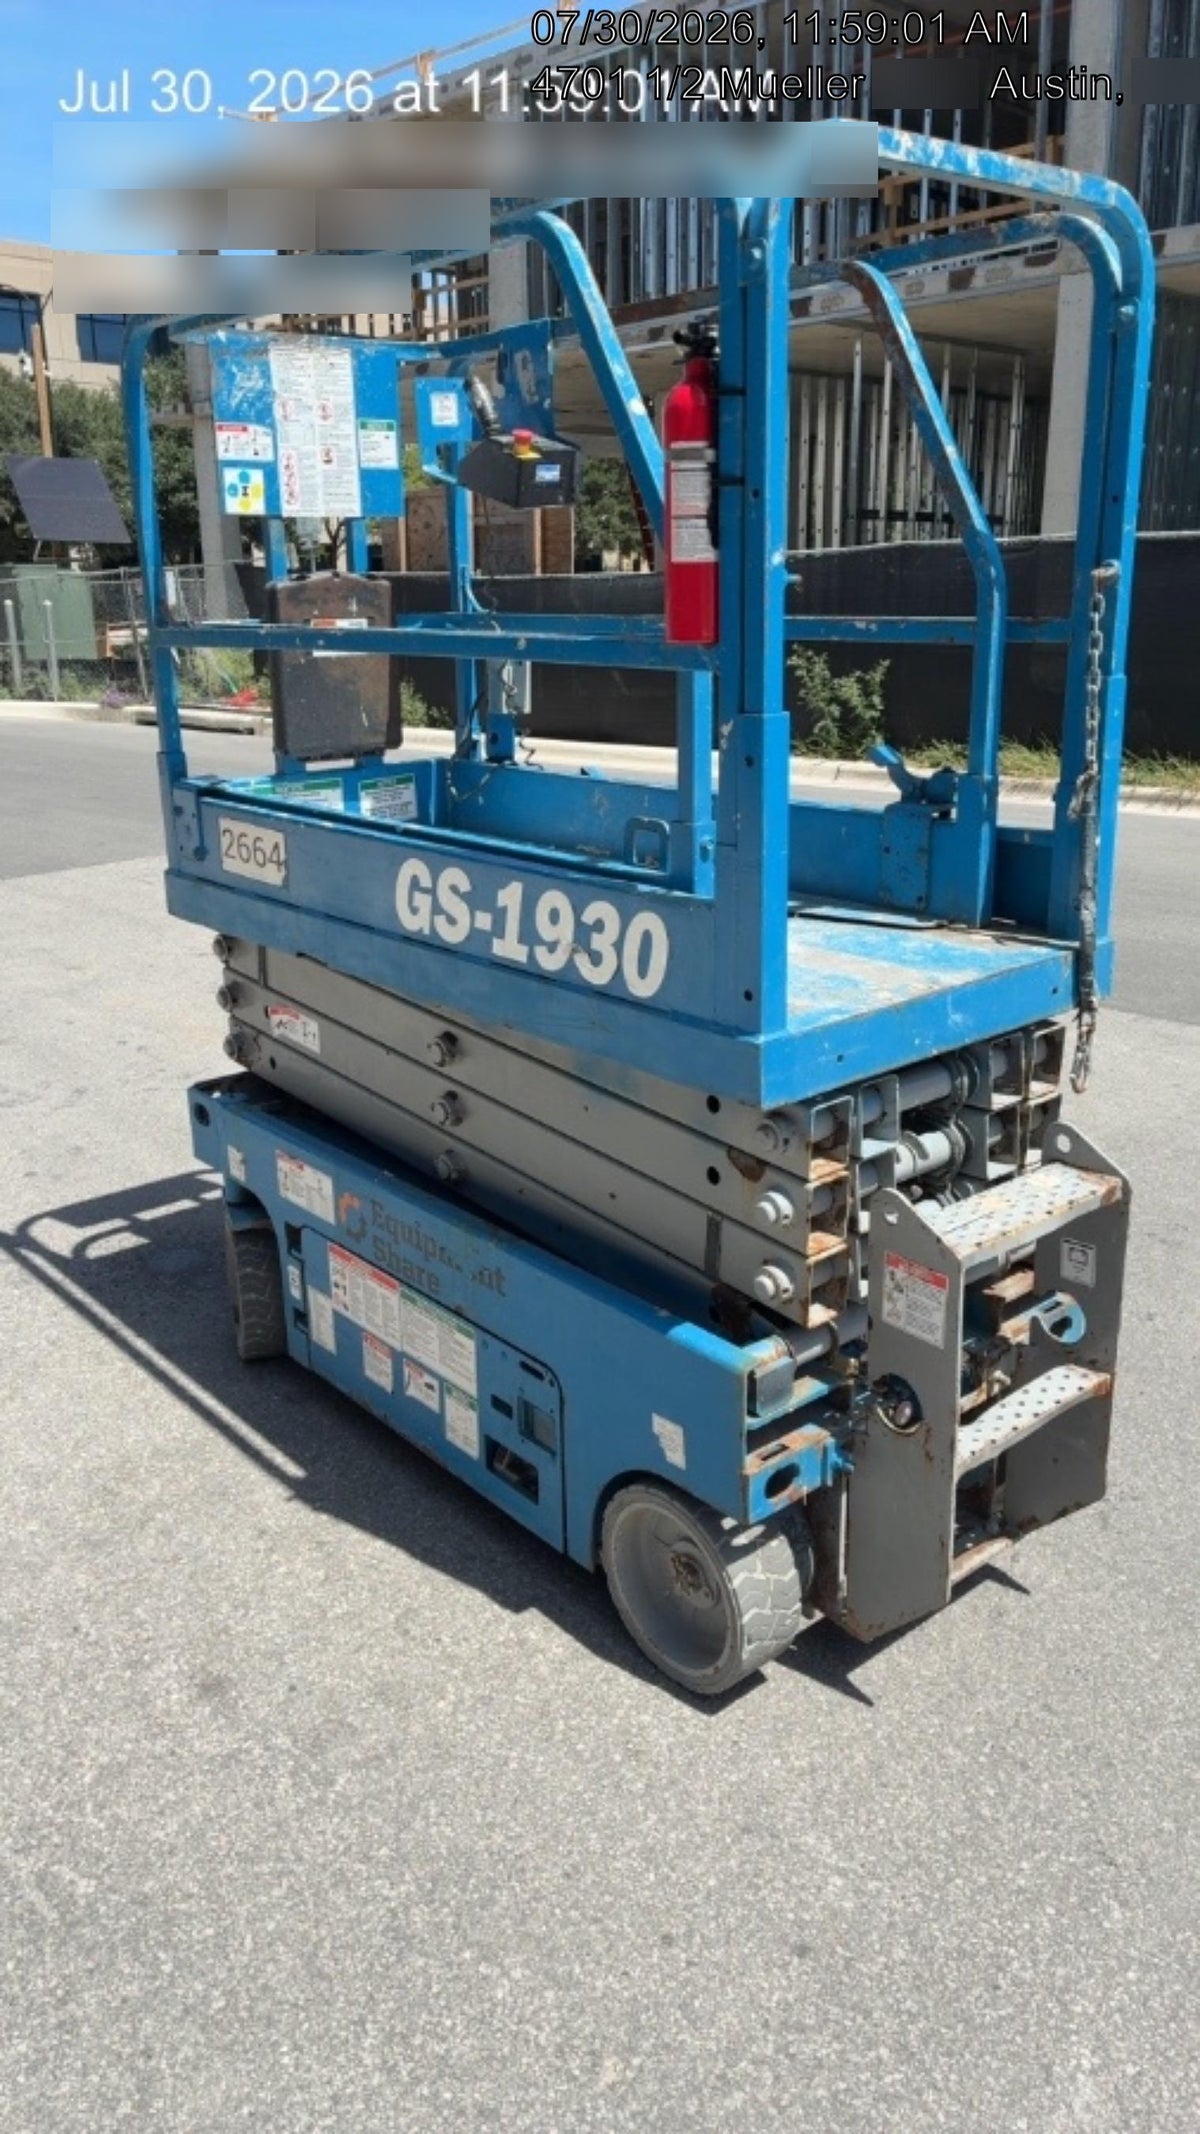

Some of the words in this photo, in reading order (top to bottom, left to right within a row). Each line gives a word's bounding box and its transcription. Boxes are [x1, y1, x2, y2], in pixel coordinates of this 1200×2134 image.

[221, 824, 286, 874] 2664
[395, 857, 669, 999] GS-1930
[371, 1234, 440, 1297] Share
